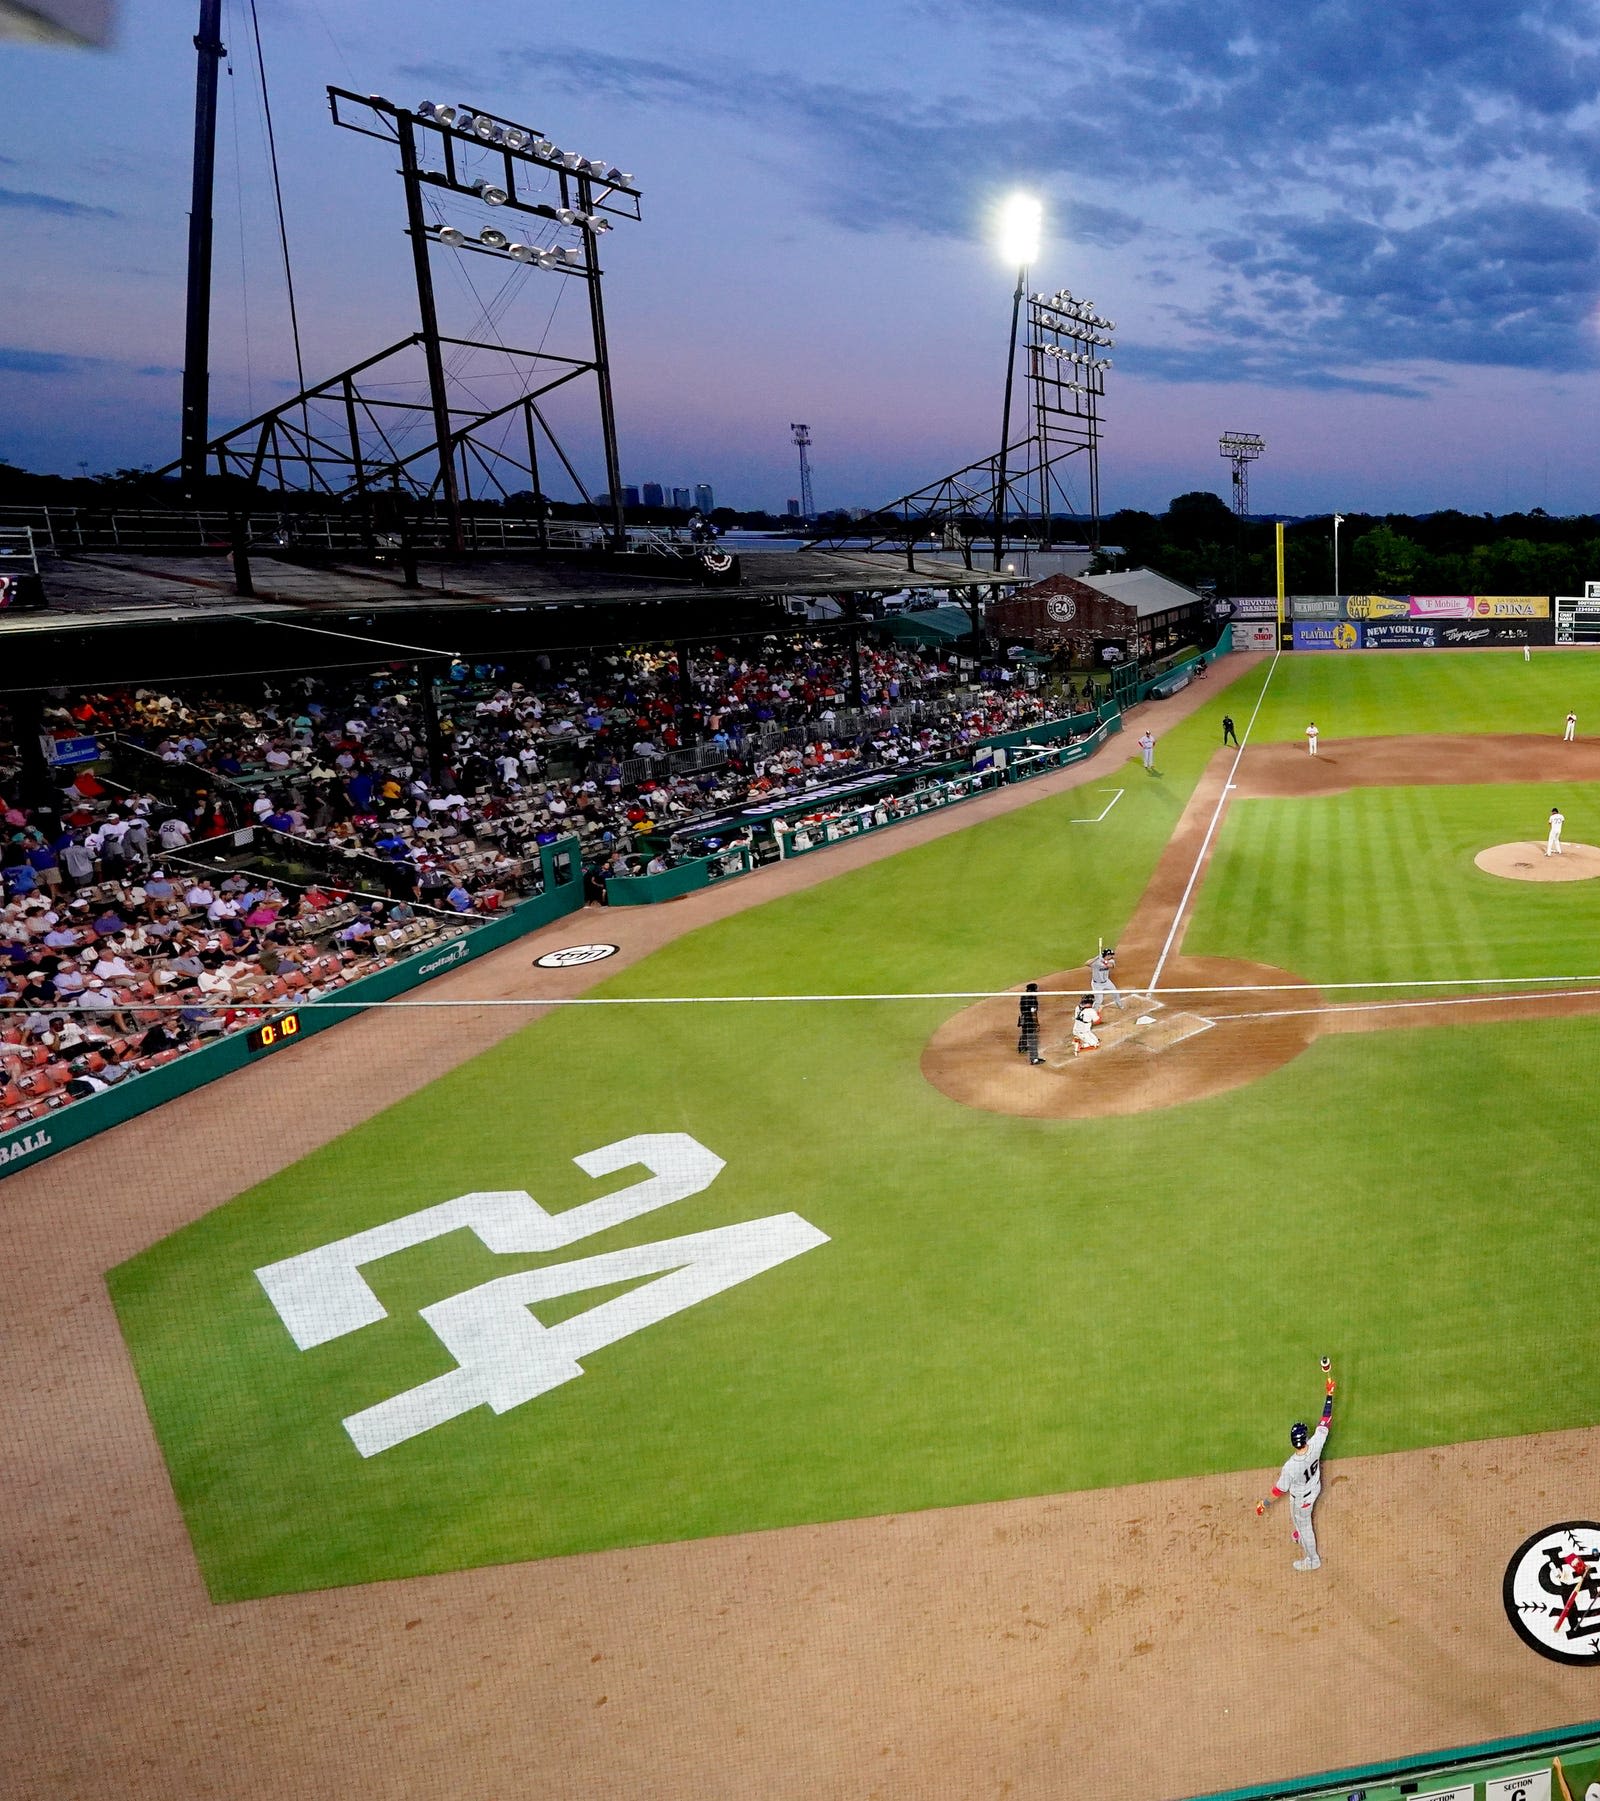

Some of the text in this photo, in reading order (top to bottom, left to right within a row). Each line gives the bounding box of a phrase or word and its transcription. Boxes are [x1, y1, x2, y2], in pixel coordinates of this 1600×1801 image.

[1055, 603, 1068, 613] 24
[1366, 627, 1389, 636] NEW
[1389, 625, 1415, 634] YORK
[1415, 626, 1435, 636] LIFE
[162, 824, 176, 833] 56
[261, 1015, 298, 1046] 0:10
[253, 1132, 832, 1458] 24
[1303, 1458, 1319, 1484] 16
[1503, 1778, 1533, 1792] SECTION
